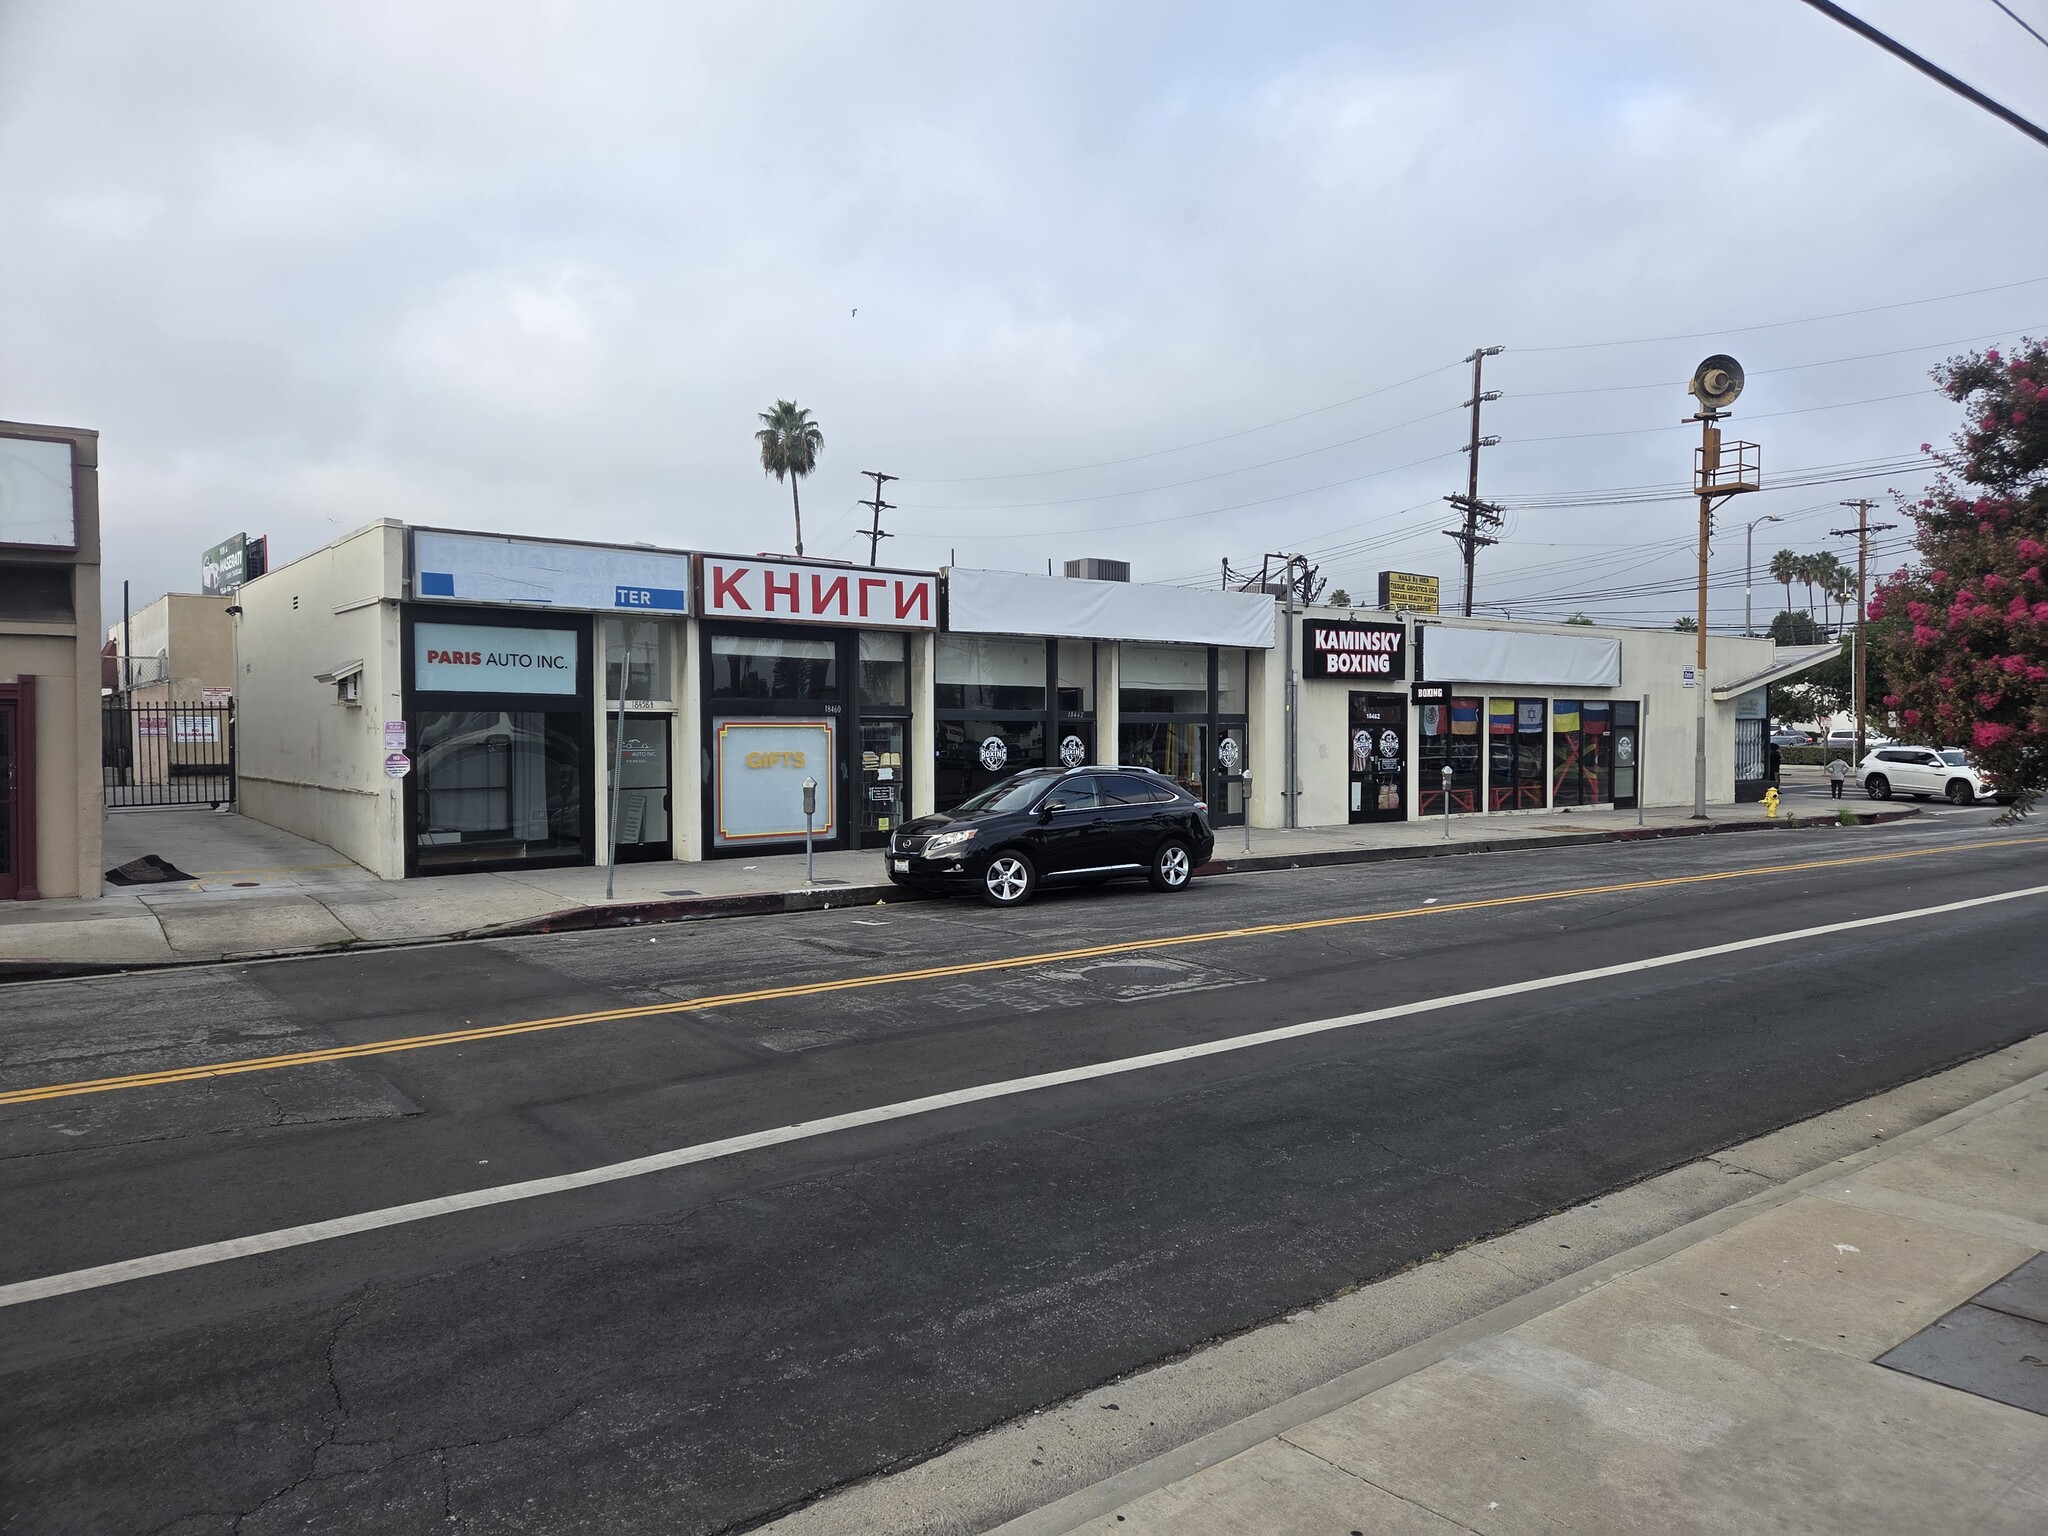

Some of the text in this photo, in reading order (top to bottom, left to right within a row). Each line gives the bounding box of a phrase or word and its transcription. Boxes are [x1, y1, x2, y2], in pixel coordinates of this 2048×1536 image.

[220, 551, 242, 573] MASERATI
[617, 589, 651, 605] TER
[713, 566, 929, 621] КНИГИ
[1315, 629, 1402, 652] KAMINSKY
[427, 649, 569, 670] PARIS AUTO INC.
[1326, 653, 1390, 673] BOXING
[1418, 688, 1443, 698] BOXING
[824, 704, 842, 714] 18460
[746, 751, 806, 769] GIFTS
[981, 749, 1007, 759] BOXING
